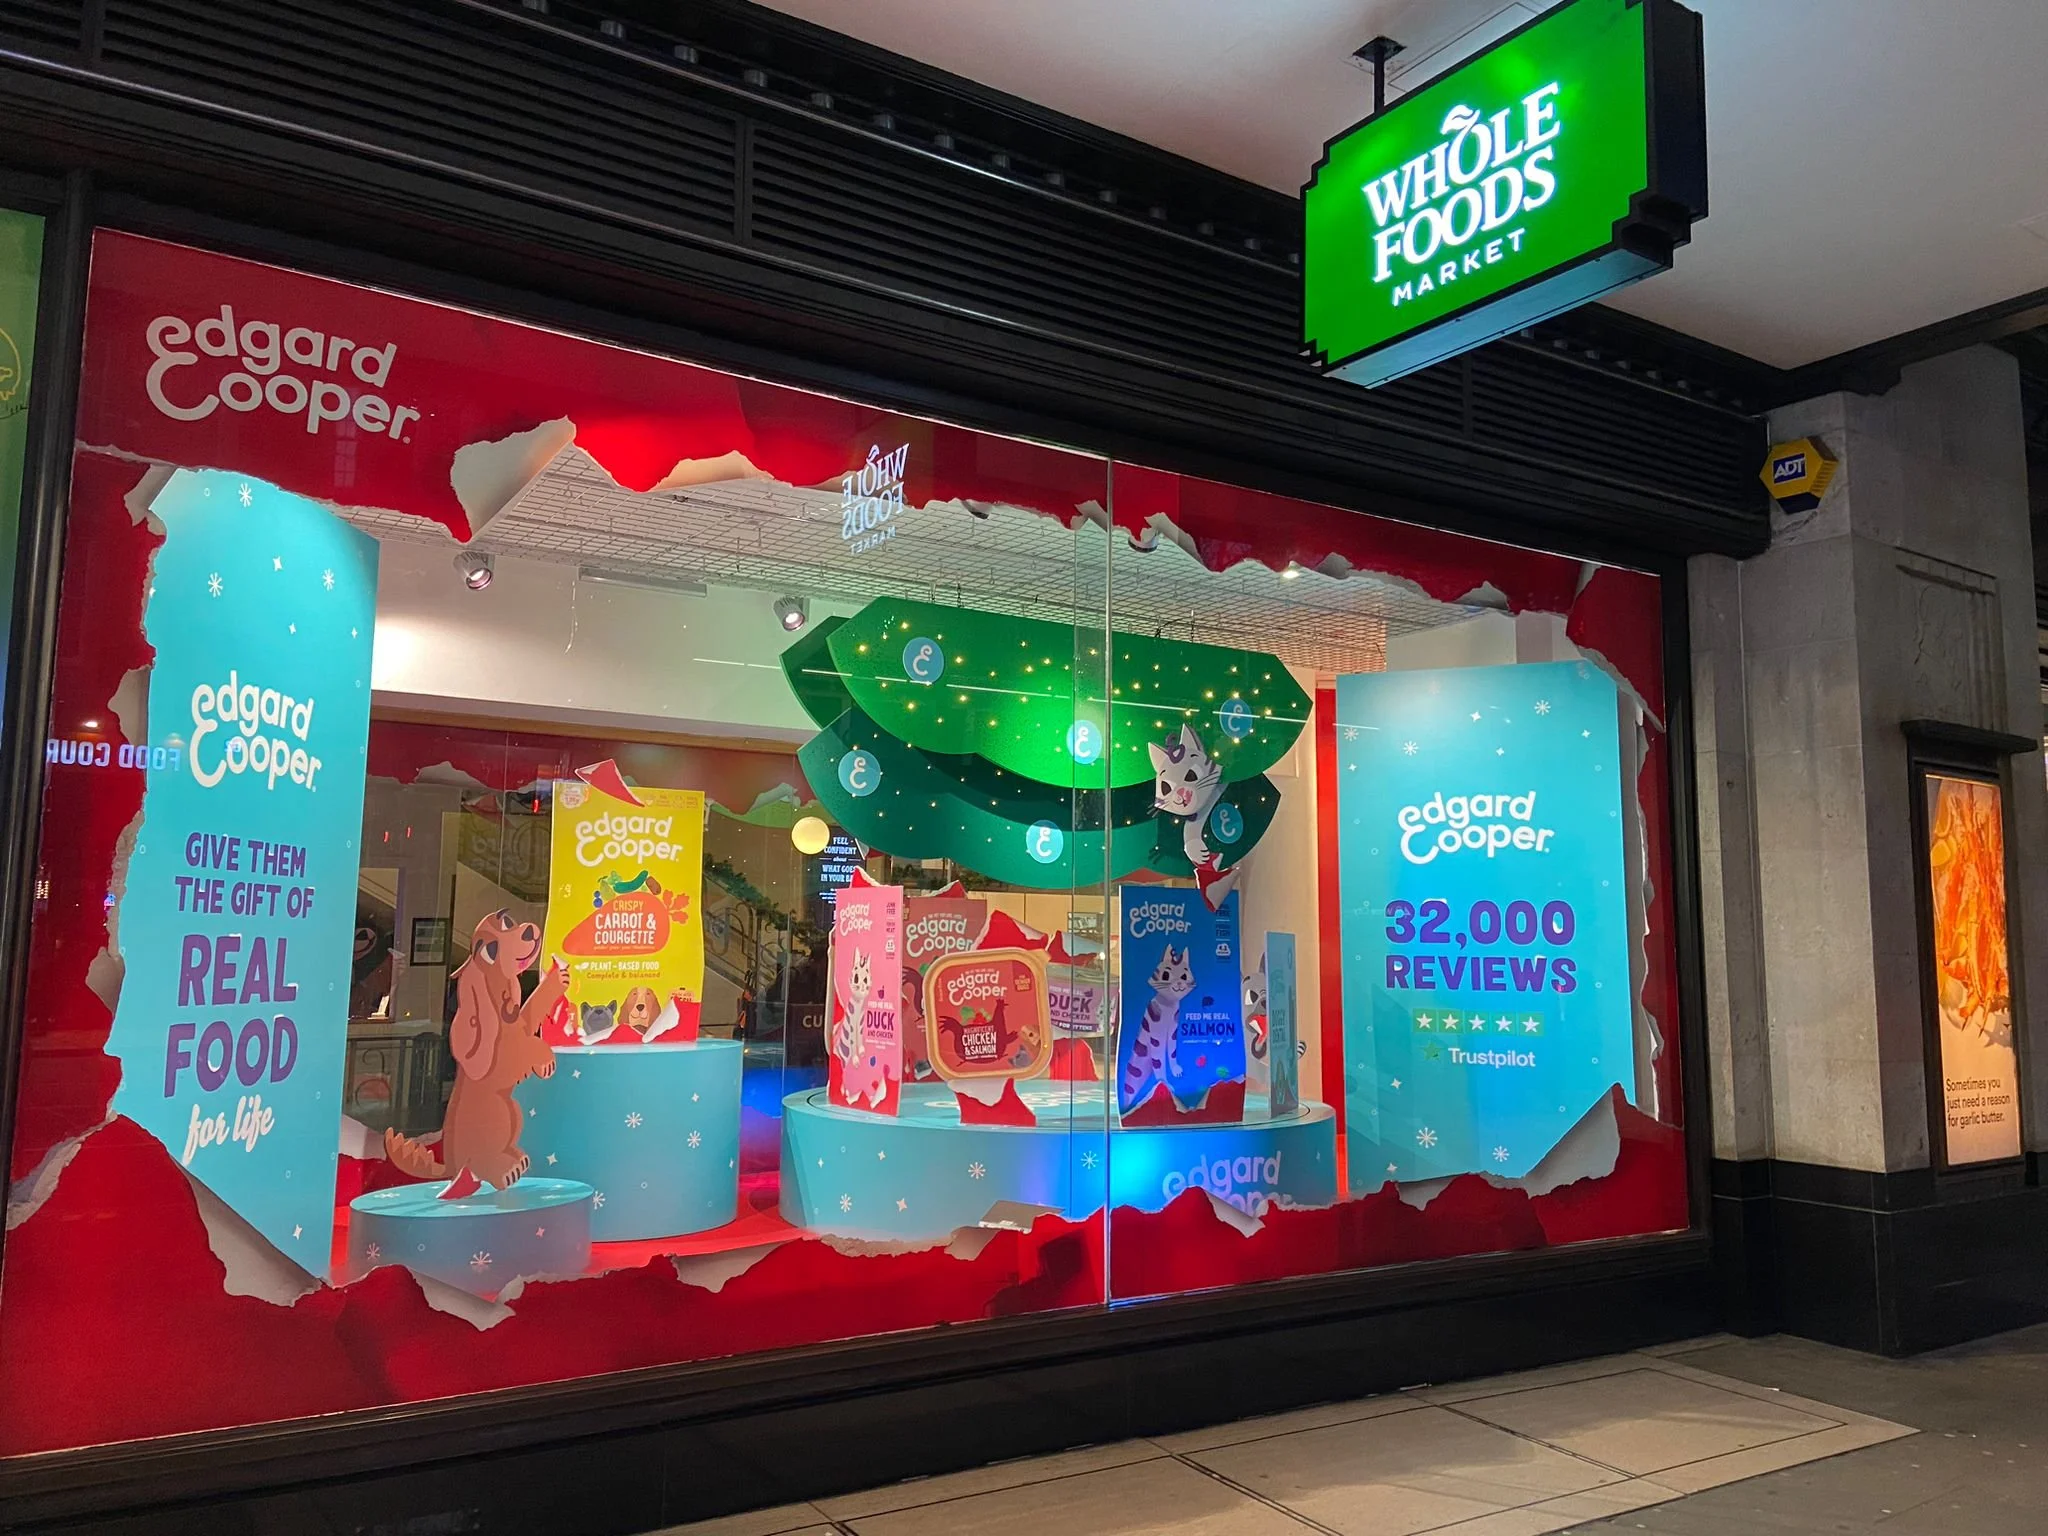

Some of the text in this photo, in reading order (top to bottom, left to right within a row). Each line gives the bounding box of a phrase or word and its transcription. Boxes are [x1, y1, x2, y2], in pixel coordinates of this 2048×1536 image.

[1361, 81, 1561, 227] WHOLE
[1372, 145, 1556, 283] FOODS
[1392, 227, 1526, 307] MARKET
[146, 304, 398, 388] edgard
[1774, 456, 1806, 480] ADT
[190, 670, 315, 741] edgard
[1398, 790, 1537, 829] edgard
[575, 811, 673, 841] edgard
[832, 836, 849, 845] FEEL
[185, 832, 307, 878] GIVE THEM
[823, 847, 857, 855] CONFIDENT
[820, 873, 828, 882] IN
[829, 873, 845, 882] YOUR
[822, 864, 841, 873] WHAT
[175, 876, 315, 919] THE GIFT OF
[613, 900, 644, 912] CRISPY
[595, 912, 657, 930] CARROT &
[840, 902, 871, 920] edgard
[1129, 901, 1185, 921] edgard
[906, 916, 968, 938] edgard
[1385, 898, 1576, 950] 32,000
[594, 930, 655, 945] COURGETTE
[177, 933, 299, 1008] REAL
[587, 971, 619, 981] Complete
[628, 971, 661, 979] balanced
[642, 961, 660, 971] FOOD
[1385, 954, 1577, 994] REVIEWS
[947, 970, 1000, 990] edgard
[1049, 993, 1093, 1013] DUCK
[866, 1010, 895, 1031] DUCK
[1185, 1012, 1230, 1020] FEED ME REAL
[962, 1032, 997, 1046] CHICKEN
[1181, 1022, 1236, 1036] SALMON
[163, 1014, 299, 1098] FOOD
[1448, 1047, 1537, 1069] Trustpilot
[1946, 1077, 2001, 1092] Sometimes you
[1946, 1094, 2010, 1112] just need a reason
[181, 1095, 276, 1165] for life
[1948, 1111, 2005, 1129] for garlic butter.
